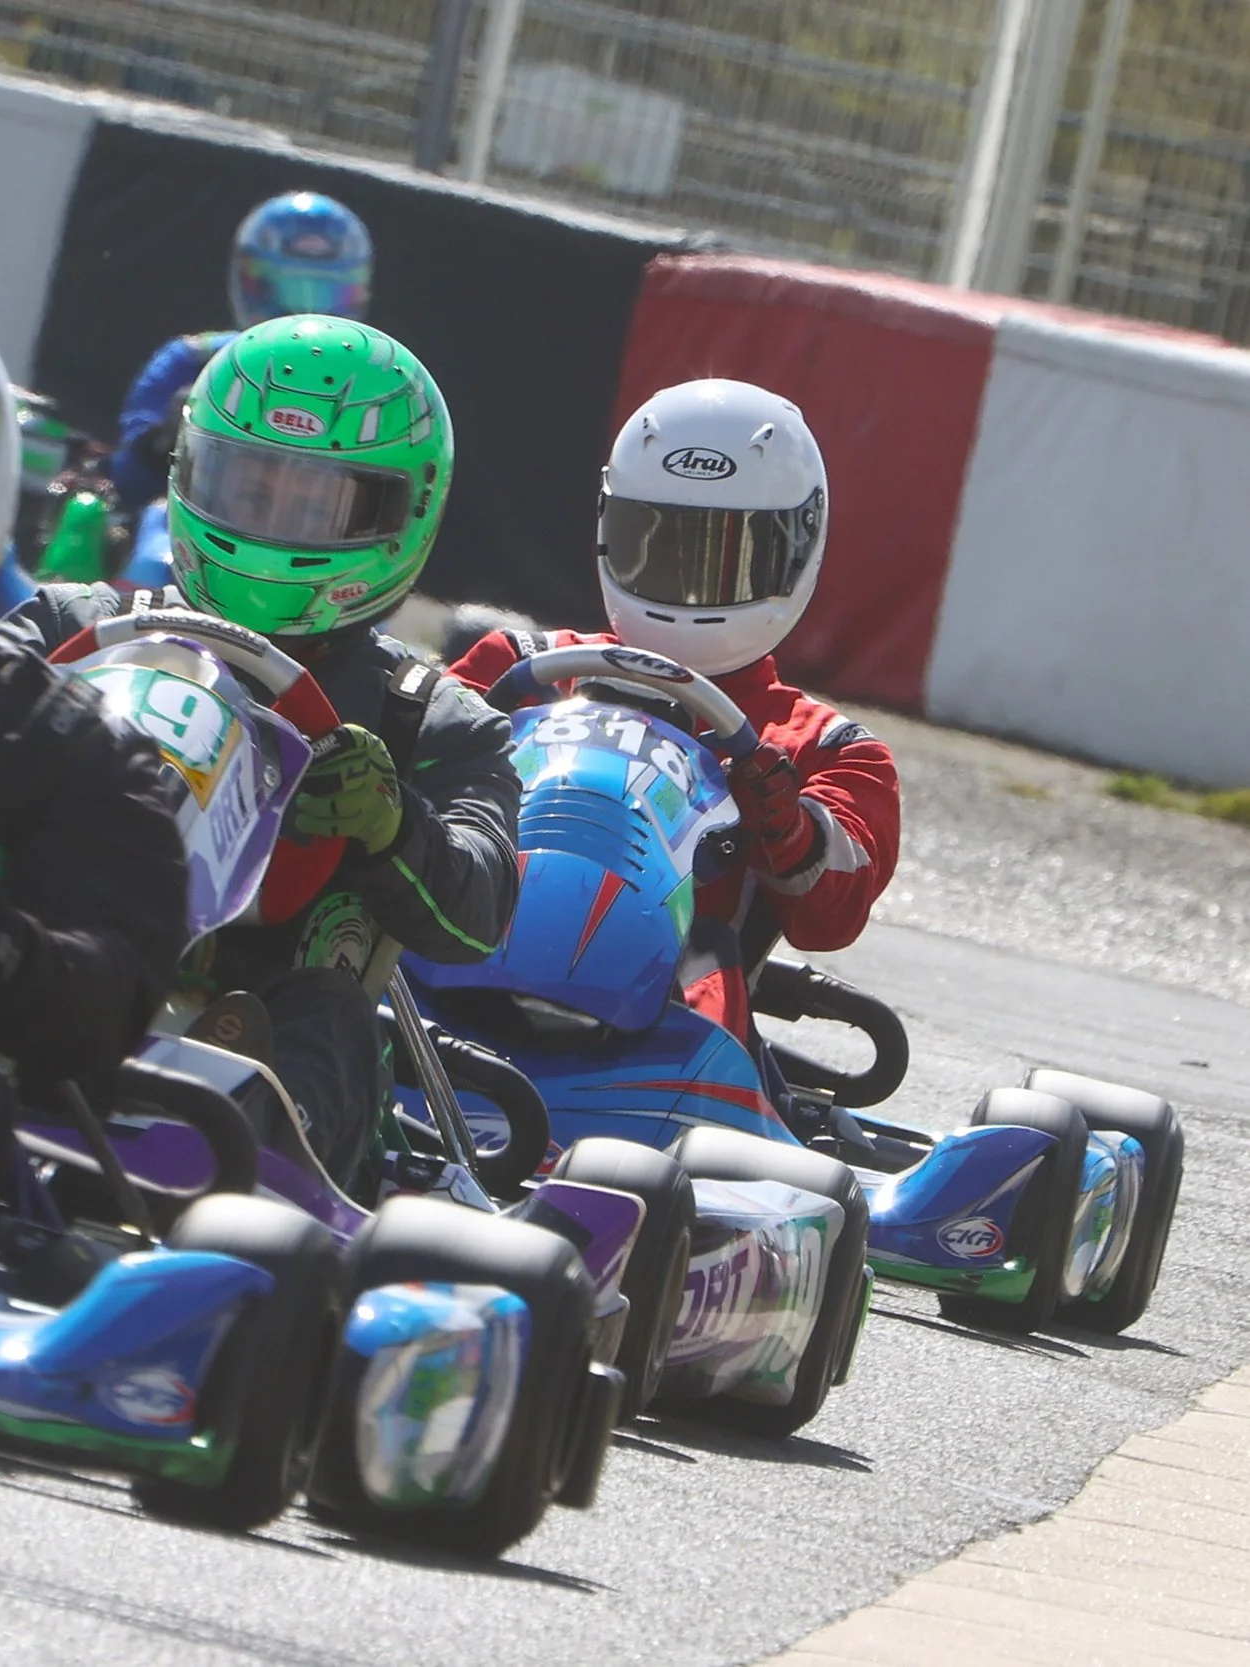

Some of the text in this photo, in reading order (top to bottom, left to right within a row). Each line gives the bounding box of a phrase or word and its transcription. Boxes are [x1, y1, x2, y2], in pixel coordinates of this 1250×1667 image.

[272, 410, 317, 433] BELL
[667, 450, 727, 473] Arai
[331, 584, 364, 600] BELL
[533, 712, 696, 799] 818
